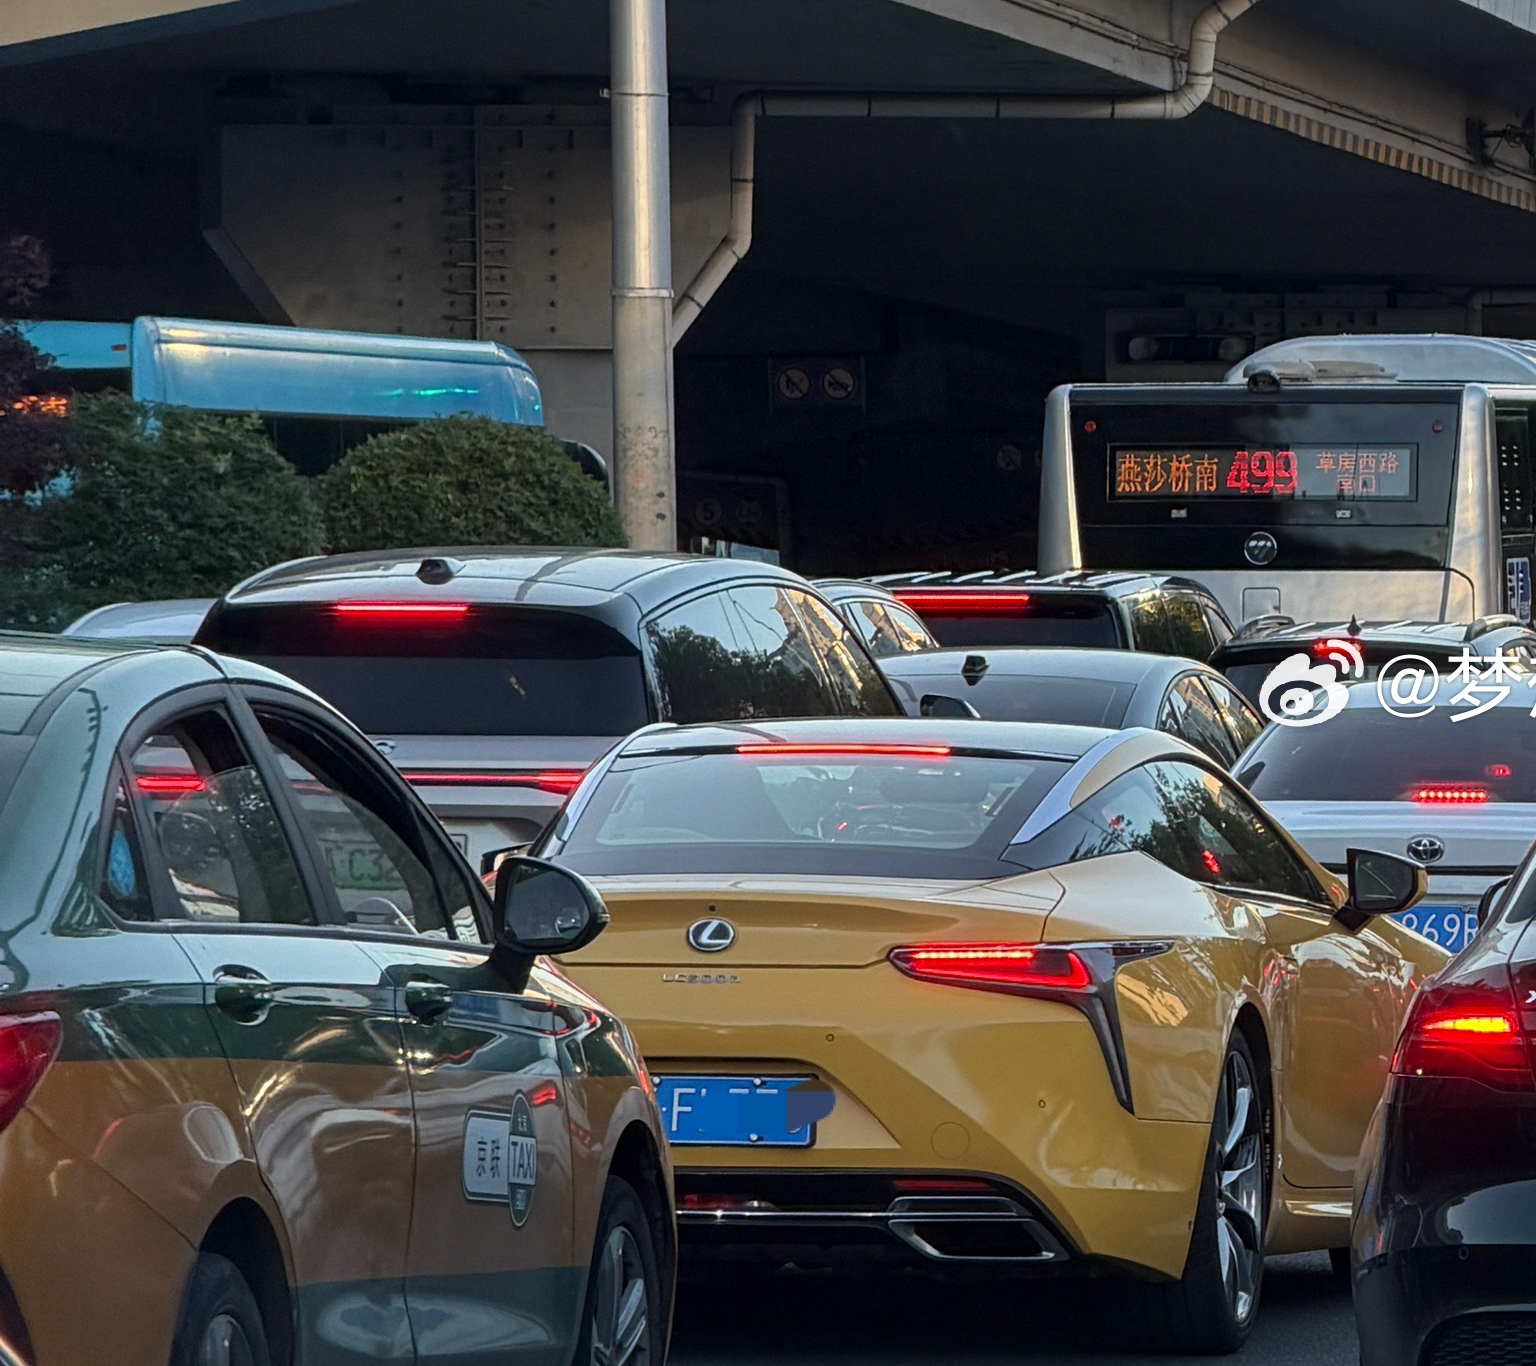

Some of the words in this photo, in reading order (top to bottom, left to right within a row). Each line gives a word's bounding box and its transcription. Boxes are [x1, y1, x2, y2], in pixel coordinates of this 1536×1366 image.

[1117, 453, 1219, 493] 燕莎桥南
[1226, 451, 1299, 494] 499
[511, 1141, 535, 1179] TAXI
